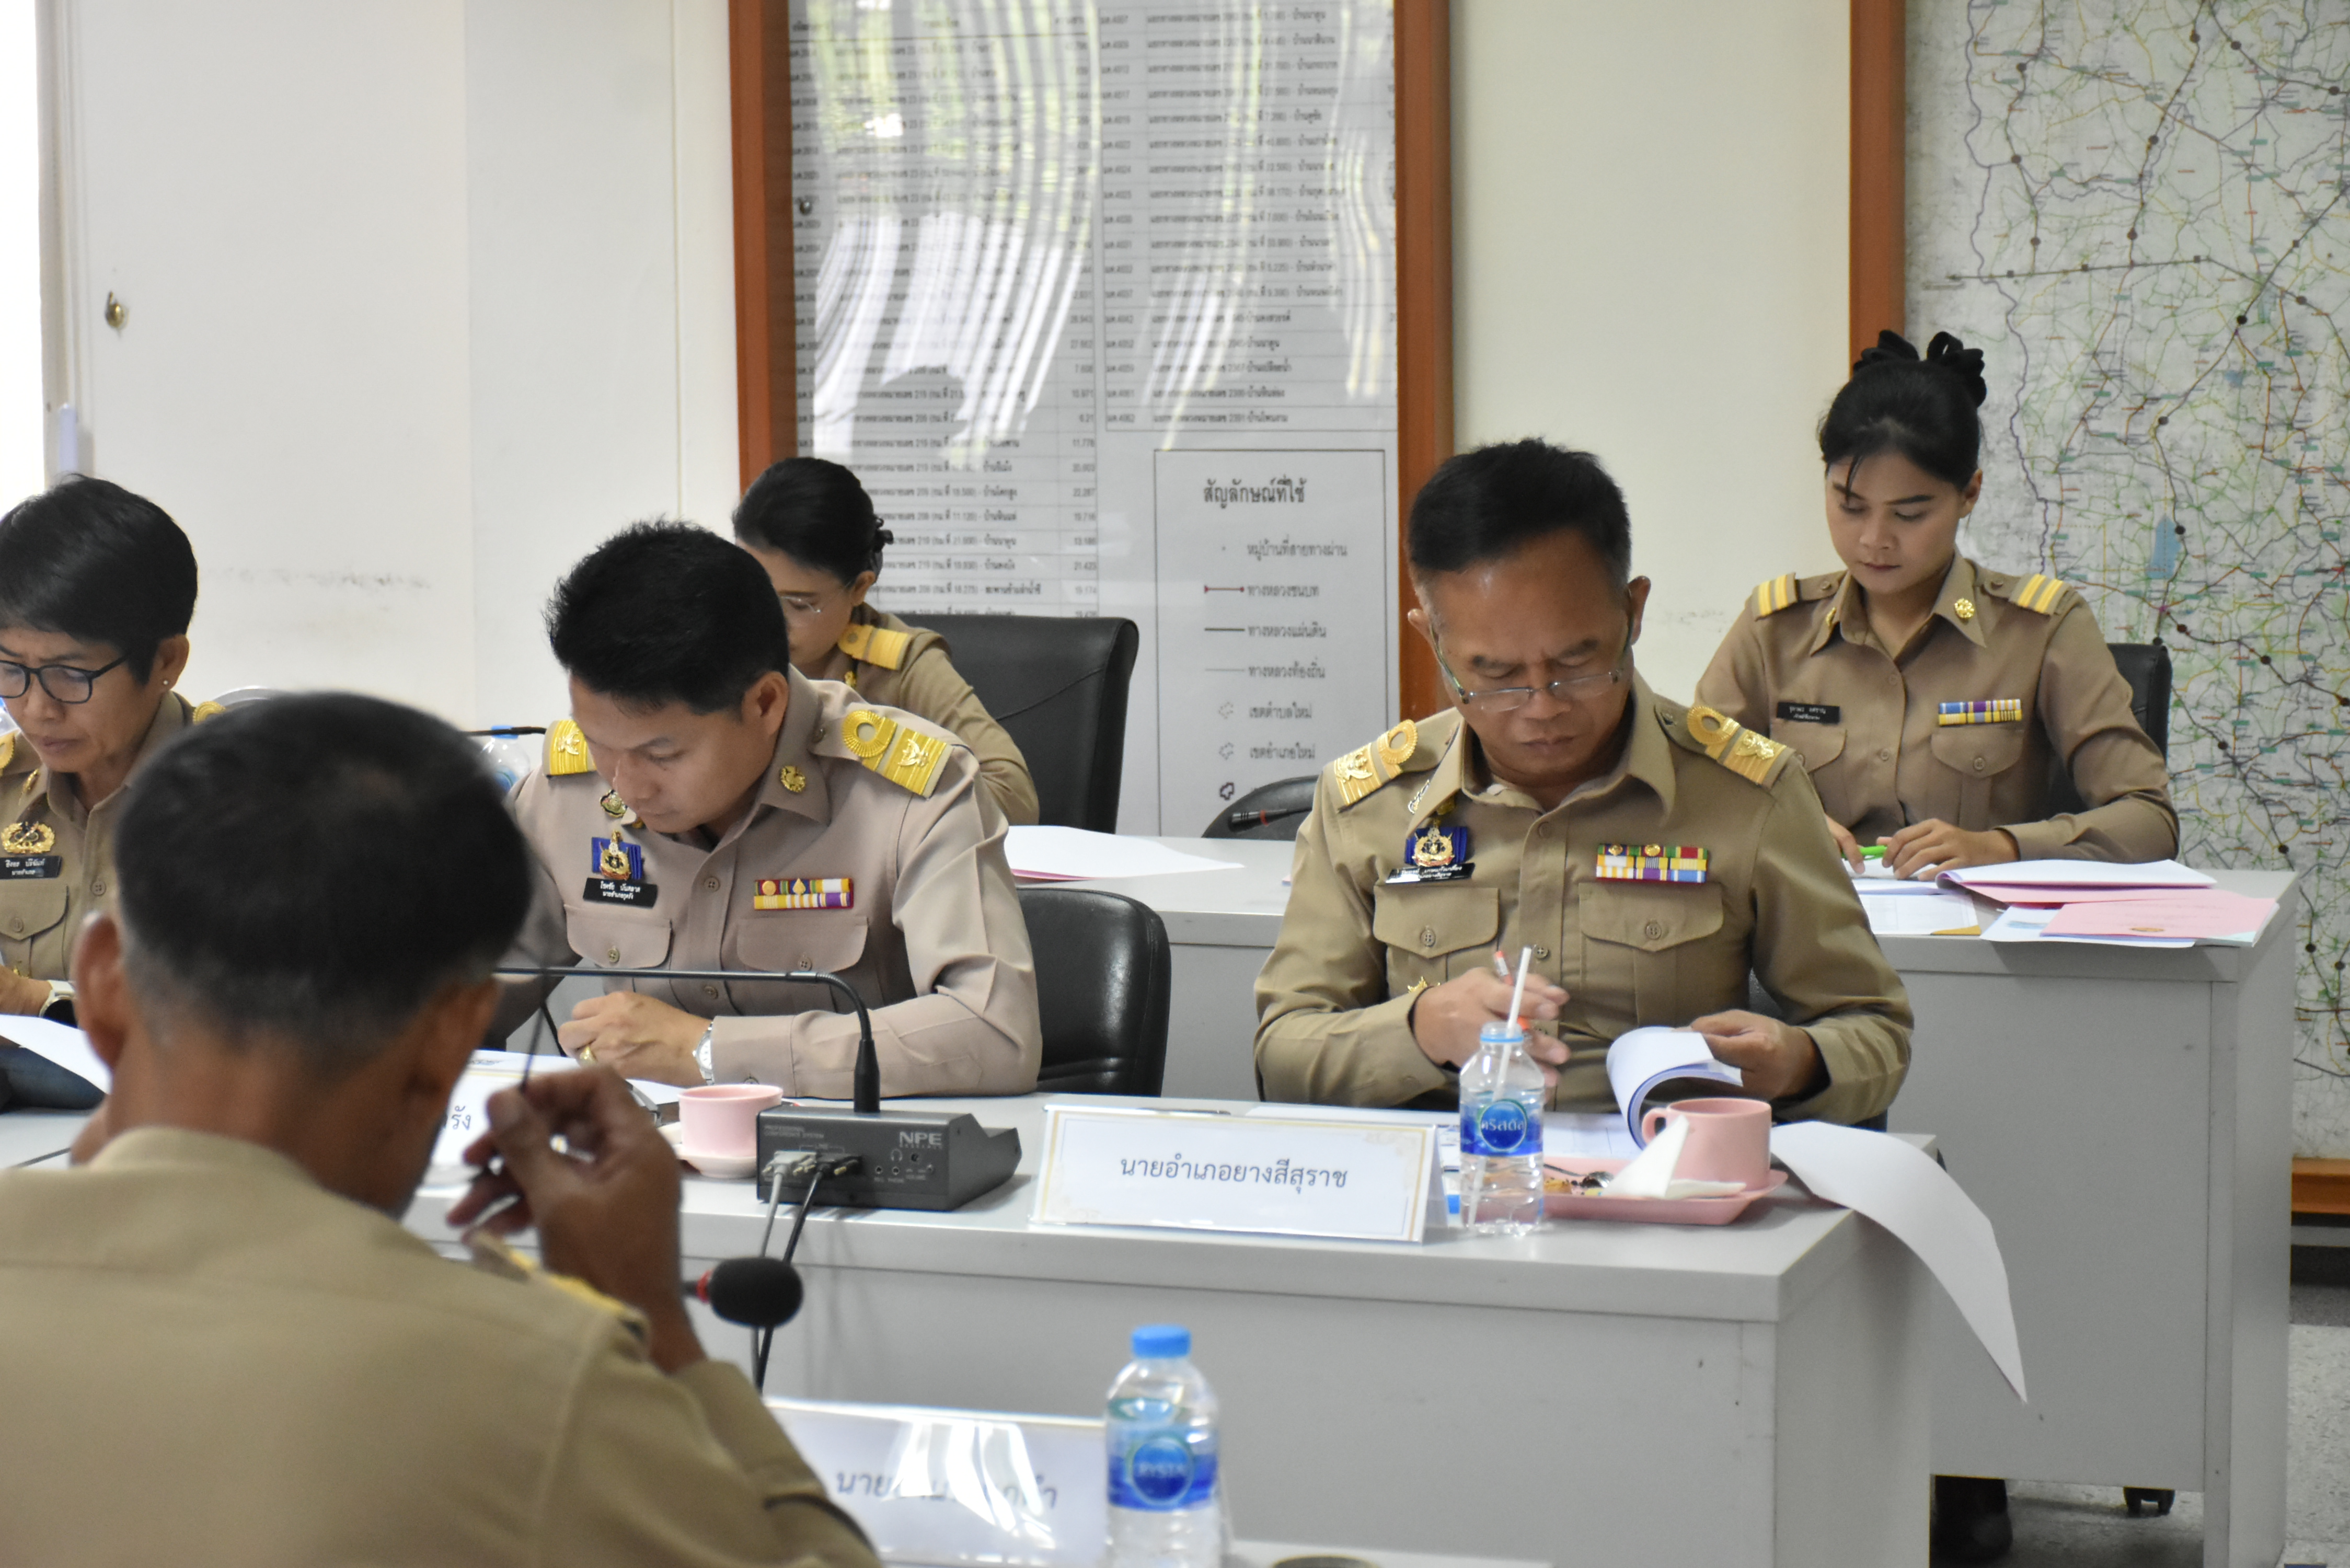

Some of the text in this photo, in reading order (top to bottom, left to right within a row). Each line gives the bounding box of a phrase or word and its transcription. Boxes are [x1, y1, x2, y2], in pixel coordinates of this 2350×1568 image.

[1204, 474, 1307, 509] สัญลักษณ์ที่ใช้
[899, 1131, 942, 1147] NPE
[1121, 1153, 1349, 1194] นายอำเภอยางสีสุราช
